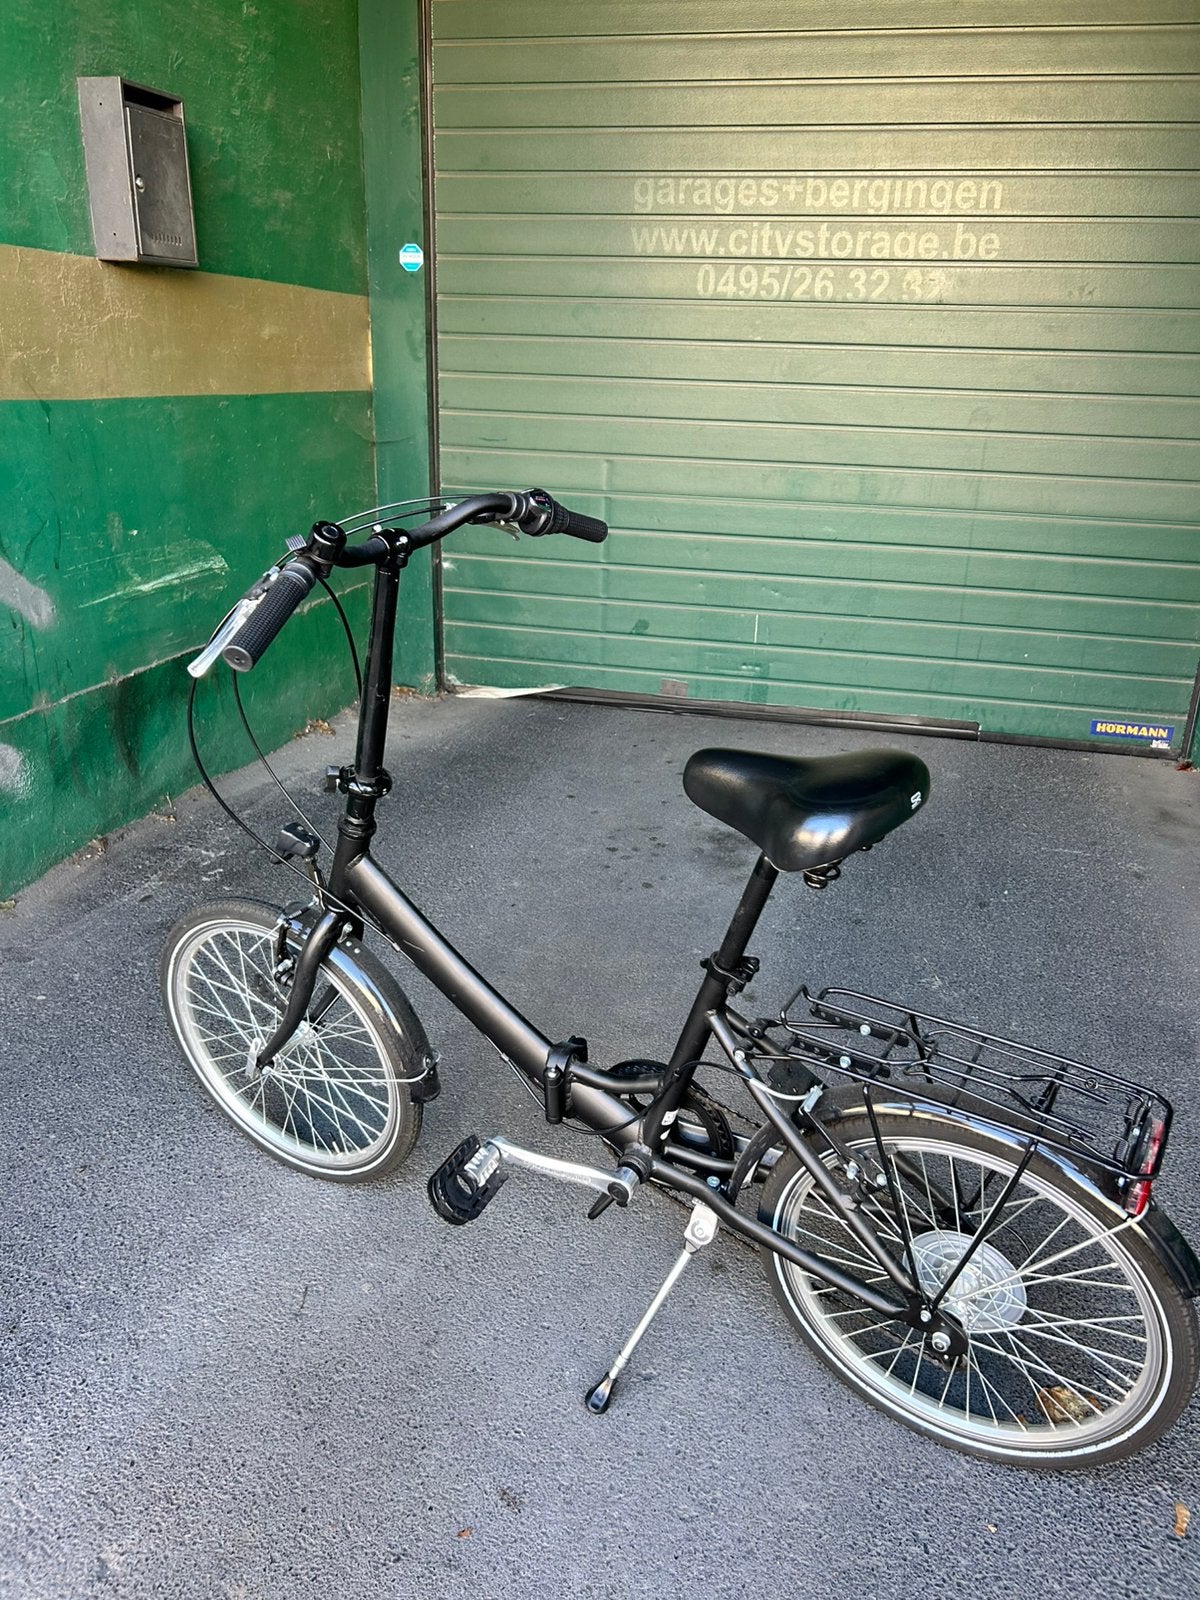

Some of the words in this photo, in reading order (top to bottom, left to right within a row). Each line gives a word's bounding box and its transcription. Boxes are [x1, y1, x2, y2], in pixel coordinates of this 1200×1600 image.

[633, 177, 1003, 213] garages+bergingen
[630, 222, 1000, 260] www.citystorage.be
[1096, 722, 1168, 738] HÖRMANN
